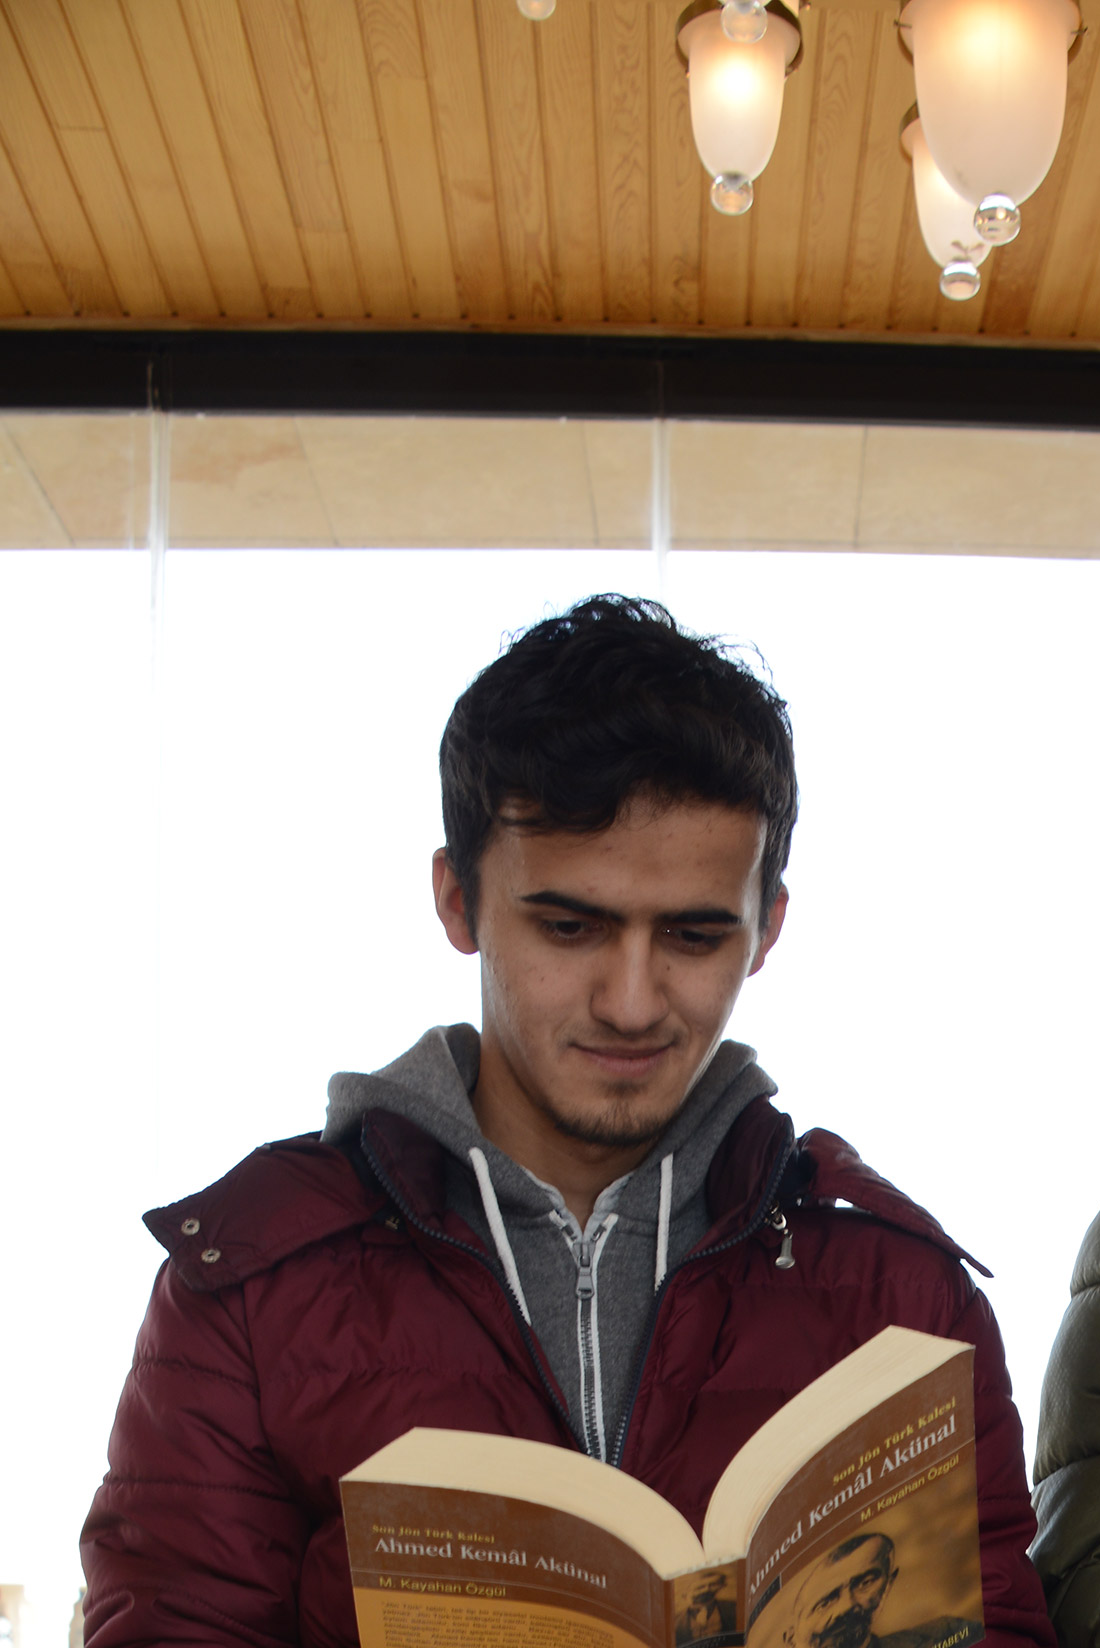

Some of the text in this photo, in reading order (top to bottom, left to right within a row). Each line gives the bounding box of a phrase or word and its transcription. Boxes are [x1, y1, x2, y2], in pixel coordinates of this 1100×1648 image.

[832, 1463, 856, 1486] Son
[857, 1446, 880, 1473] Jön
[884, 1423, 914, 1449] Türk
[748, 1414, 956, 1602] Ahmed Kemâl Akünal
[860, 1453, 960, 1523] M. Kayahan Özgül
[371, 1524, 396, 1535] Son
[424, 1528, 454, 1540] Türk
[374, 1538, 608, 1590] Ahmed Kemâl Akünal
[379, 1576, 507, 1598] M. Kayahan Özgül
